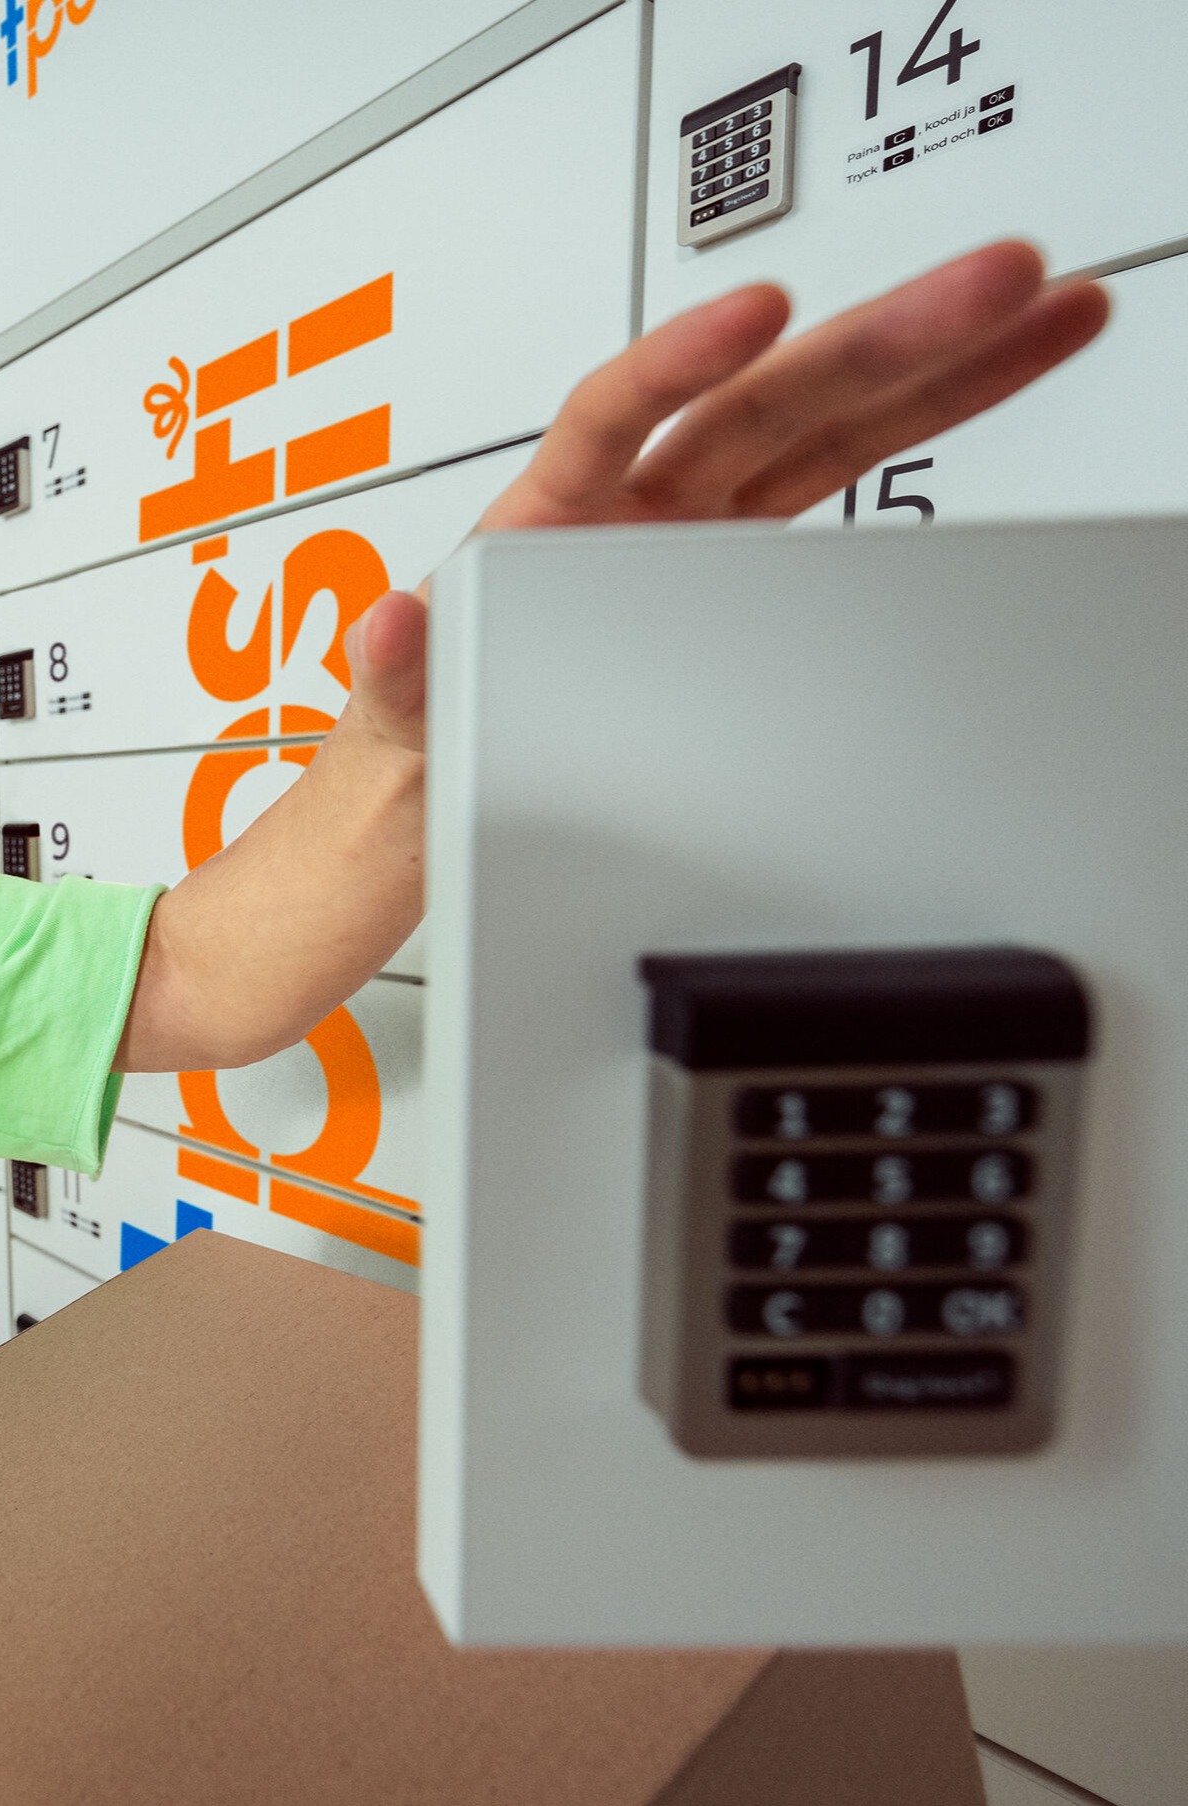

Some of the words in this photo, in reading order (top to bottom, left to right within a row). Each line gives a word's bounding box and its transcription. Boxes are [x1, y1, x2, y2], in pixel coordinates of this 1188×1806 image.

[850, 0, 980, 120] 14
[698, 149, 707, 161] 4
[725, 137, 733, 150] 5
[753, 124, 762, 137] 6
[700, 131, 708, 143] 1
[725, 119, 734, 131] 2
[753, 105, 762, 118] 3
[847, 144, 880, 163] Paina
[893, 132, 906, 144] C
[925, 109, 961, 131] koodi
[963, 105, 976, 118] ja
[988, 90, 1006, 105] OK
[699, 167, 707, 180] 7
[724, 156, 733, 169] 8
[751, 144, 760, 157] 9
[846, 166, 878, 184] Tryck
[892, 153, 905, 166] C
[924, 137, 947, 154] kod
[951, 128, 975, 143] och
[987, 113, 1005, 128] OK
[697, 186, 707, 198] C
[723, 175, 732, 188] 0
[745, 161, 765, 178] OK
[42, 422, 60, 469] 7
[49, 642, 68, 682] 8
[51, 822, 70, 861] 9
